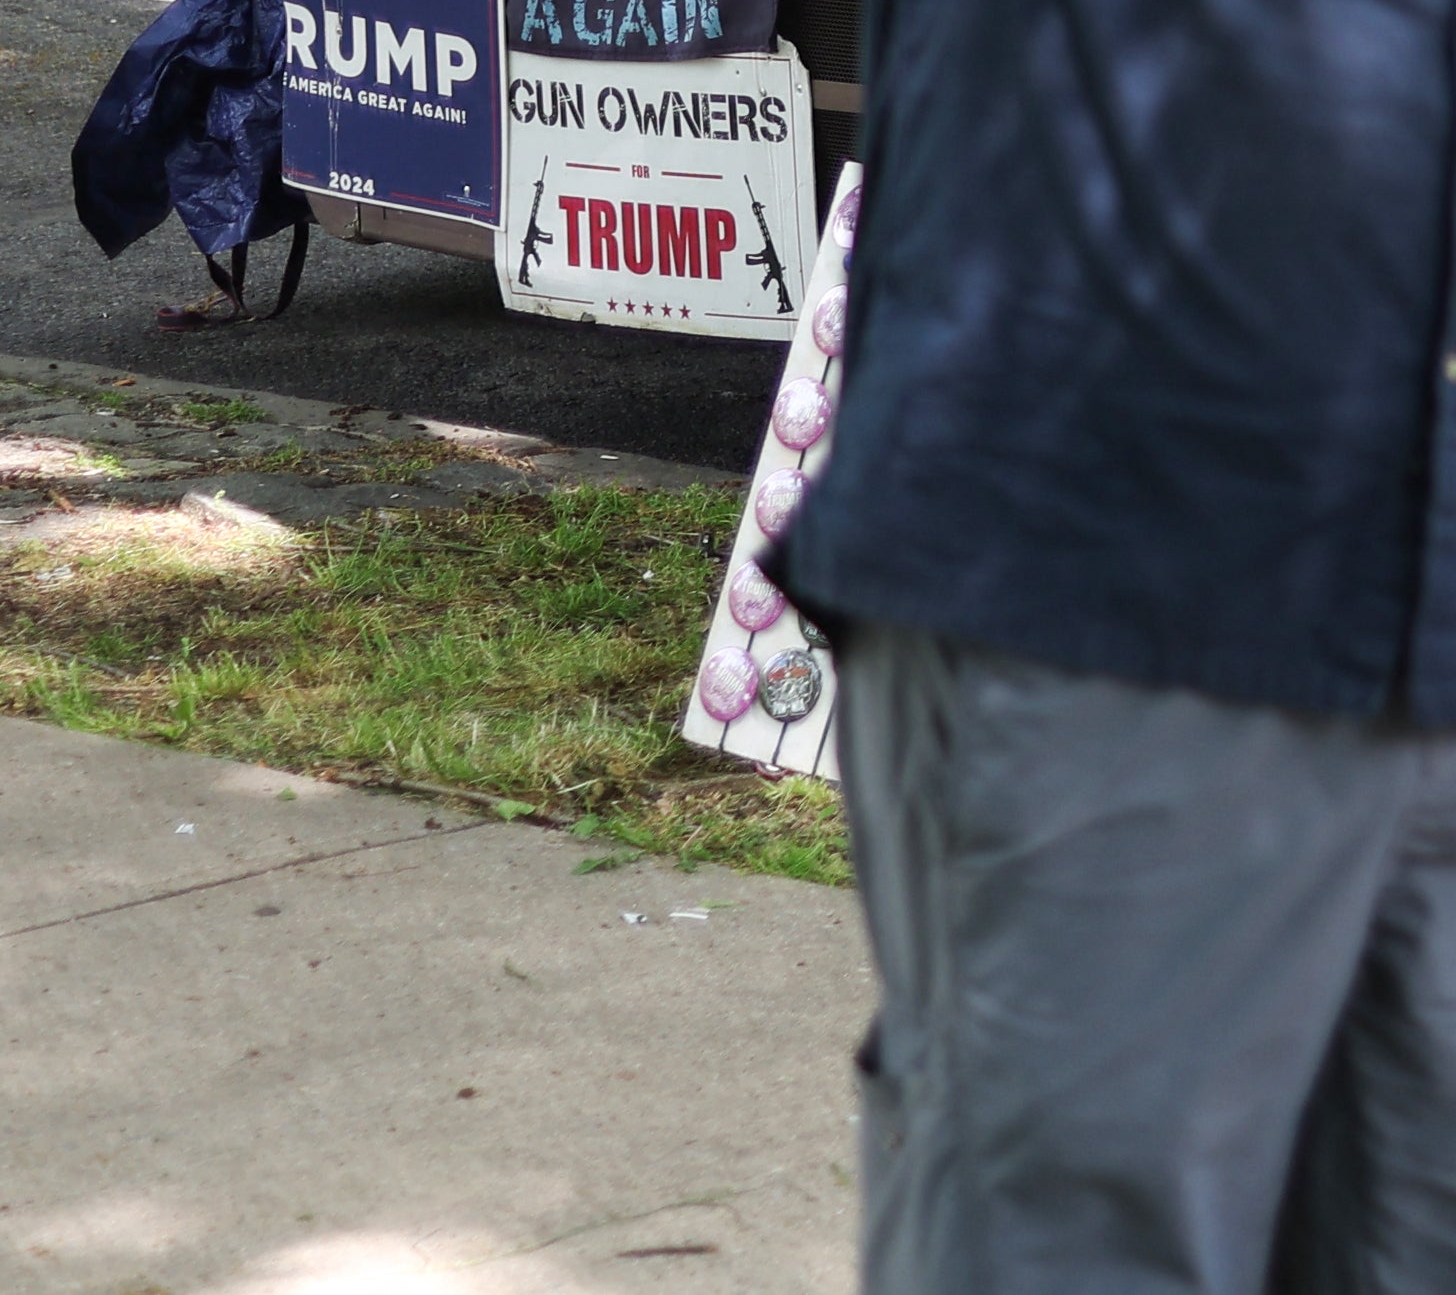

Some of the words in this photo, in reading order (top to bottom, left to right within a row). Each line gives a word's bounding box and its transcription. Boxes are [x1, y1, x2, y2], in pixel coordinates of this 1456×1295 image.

[286, 2, 477, 97] RUMP
[289, 75, 355, 105] AMERICA
[358, 87, 406, 113] GREAT
[412, 98, 467, 126] AGAIN!
[509, 80, 586, 130] GUN
[598, 86, 786, 142] OWNERS
[328, 172, 375, 197] 2024
[631, 163, 650, 178] FOR
[559, 195, 737, 280] TRUMP
